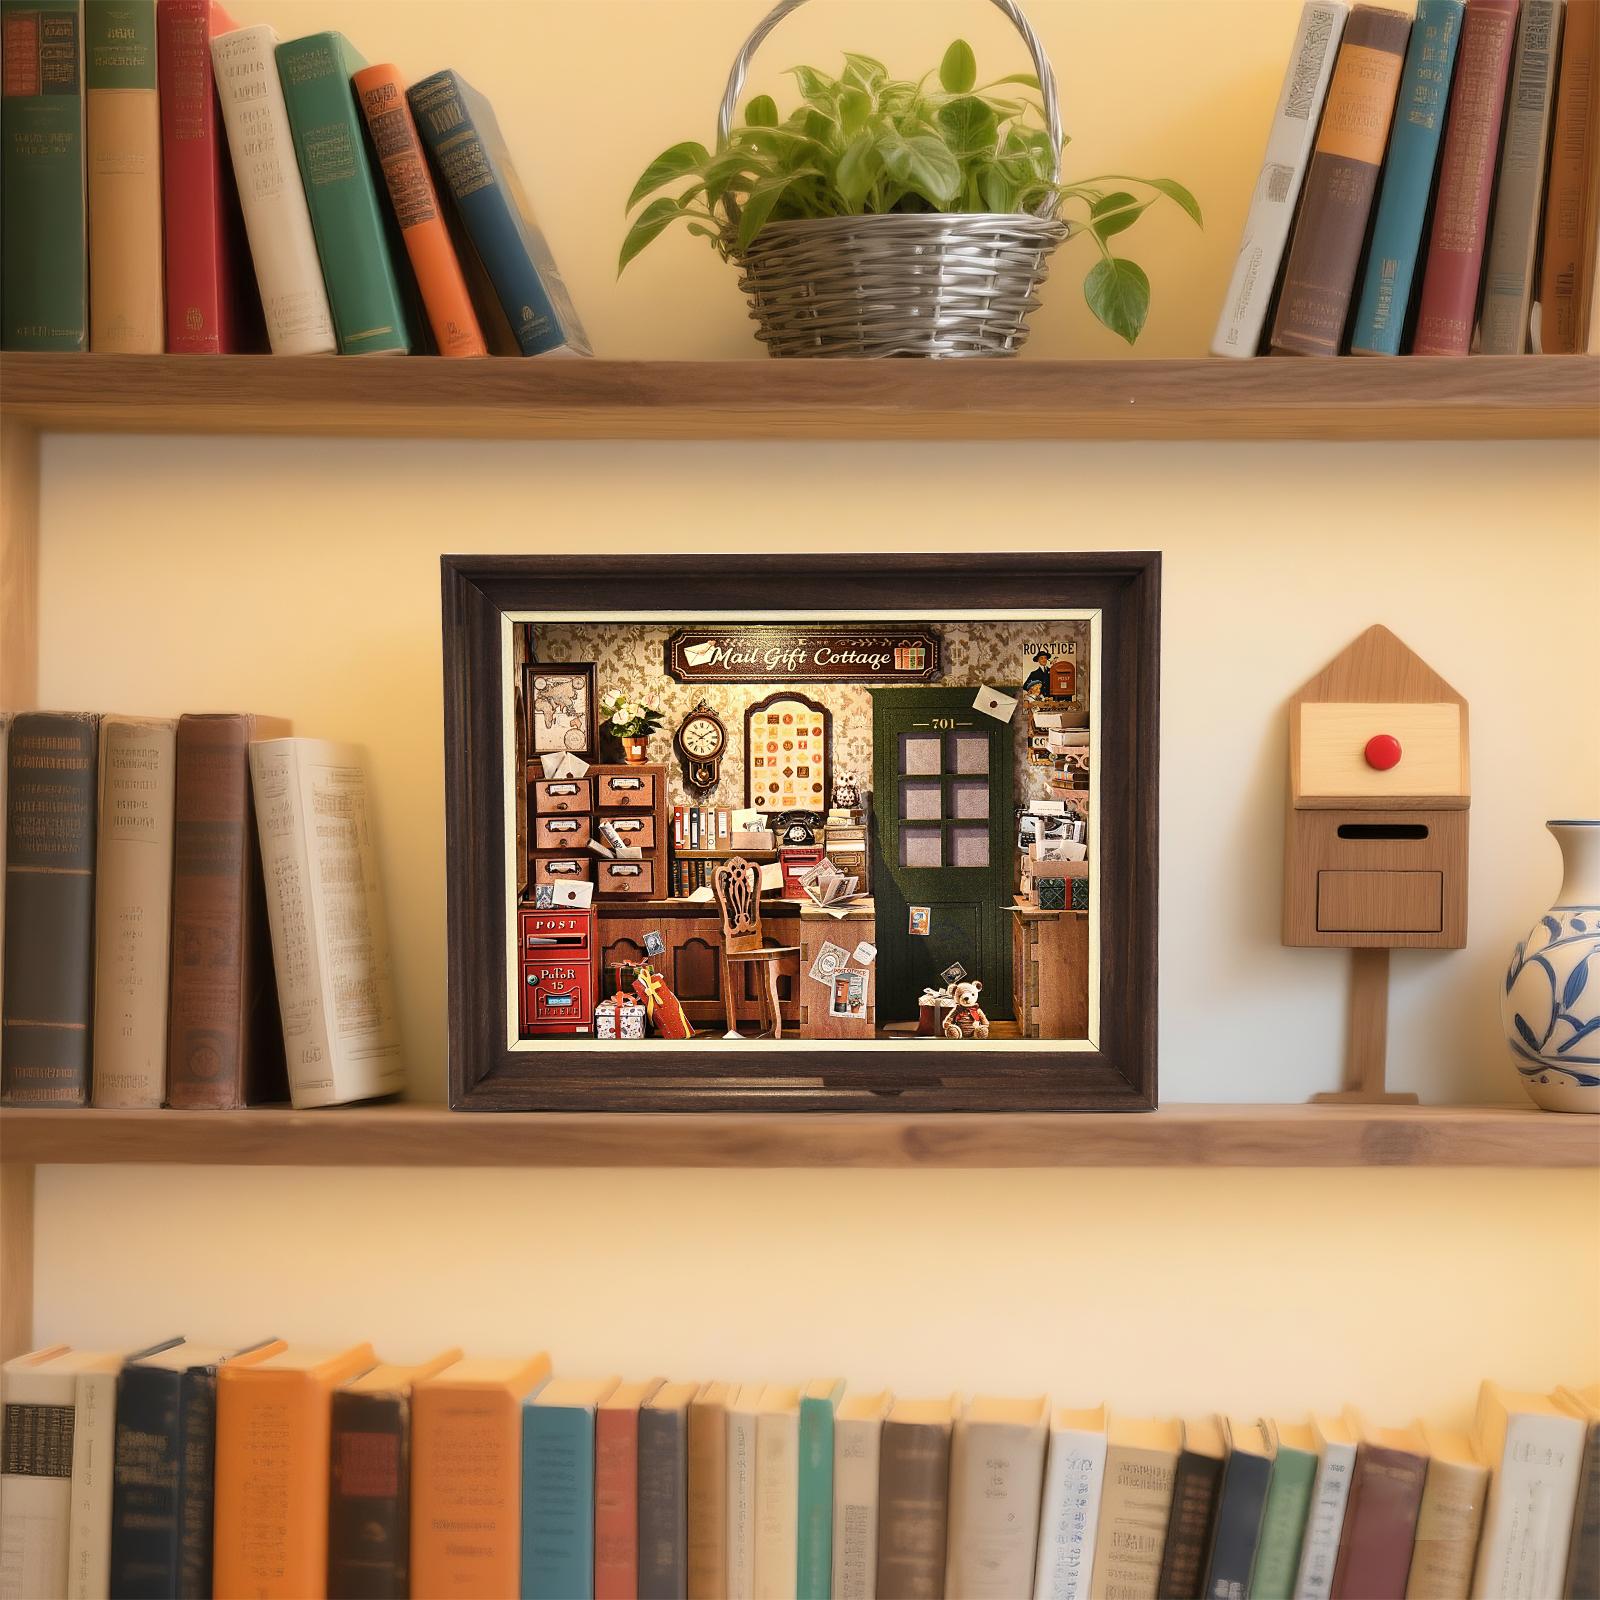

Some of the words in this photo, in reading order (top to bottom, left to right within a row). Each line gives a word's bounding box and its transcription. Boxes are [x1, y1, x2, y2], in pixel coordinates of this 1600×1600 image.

[1023, 643, 1075, 655] ROYSTICE
[709, 647, 757, 669] Mail
[763, 647, 807, 671] Gift
[813, 647, 892, 670] Cottage
[931, 718, 955, 729] 701
[535, 920, 577, 930] POST
[551, 981, 564, 991] 15
